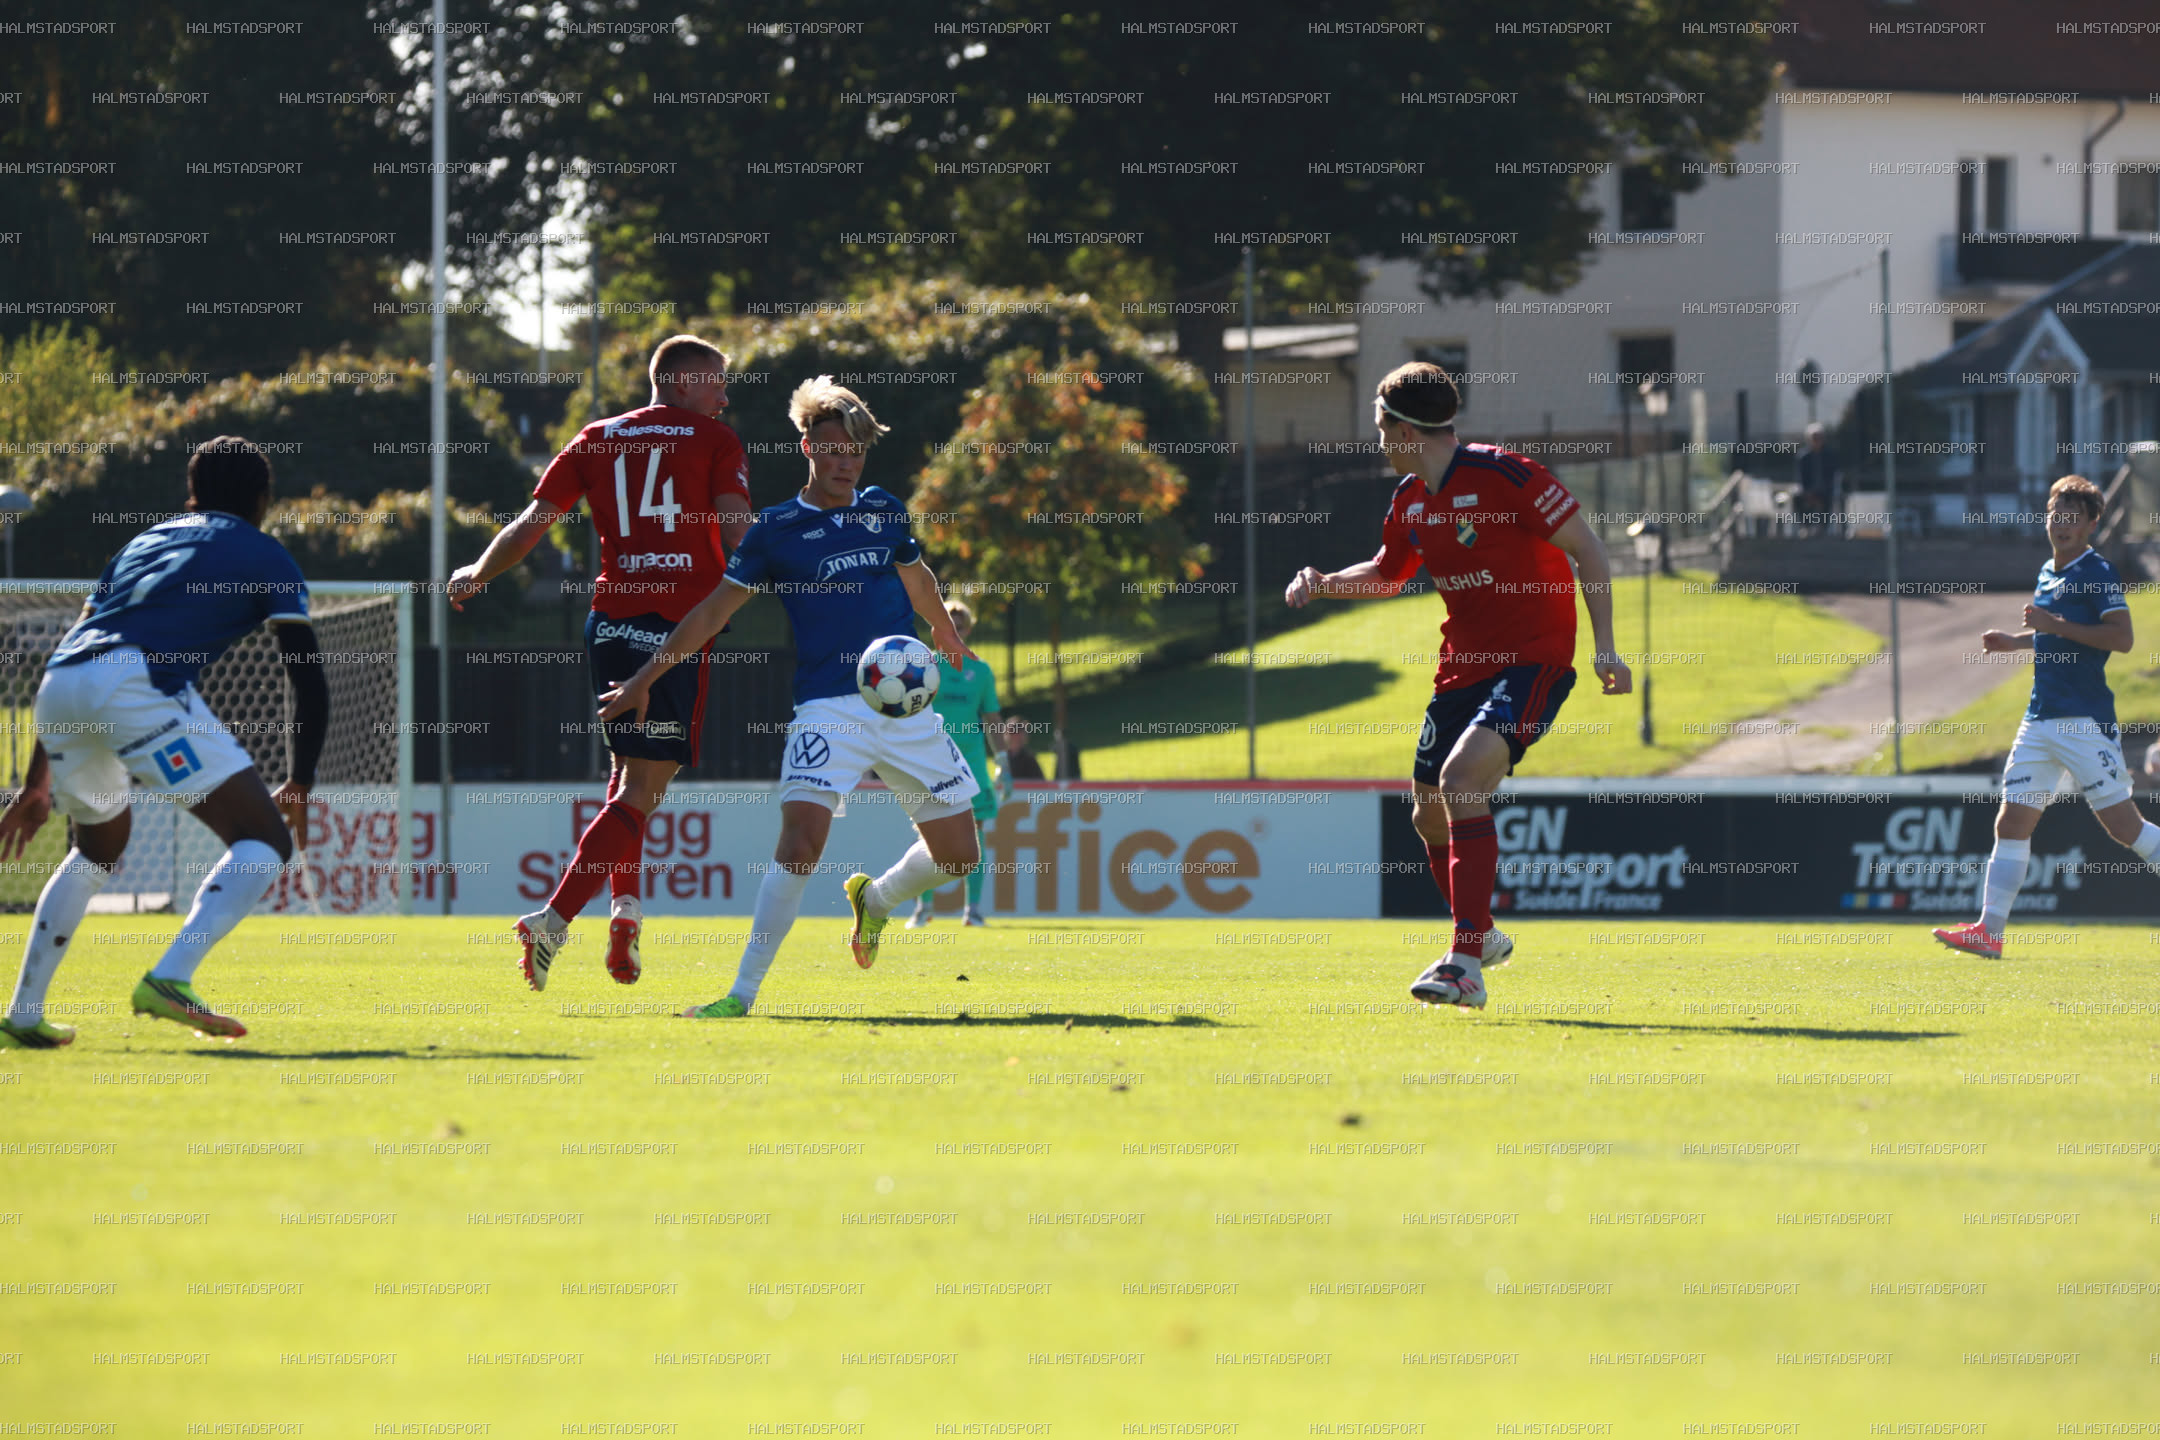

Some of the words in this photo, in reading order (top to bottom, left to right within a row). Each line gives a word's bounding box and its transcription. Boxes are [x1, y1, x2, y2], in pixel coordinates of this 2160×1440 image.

[614, 447, 682, 537] 14
[618, 553, 693, 573] dynacon
[826, 551, 880, 577] JONAR
[596, 621, 669, 645] GoAhead
[1495, 805, 1568, 852] GN
[1886, 806, 1963, 852] GN
[914, 801, 1260, 914] ffice
[1497, 845, 1690, 910] ansport
